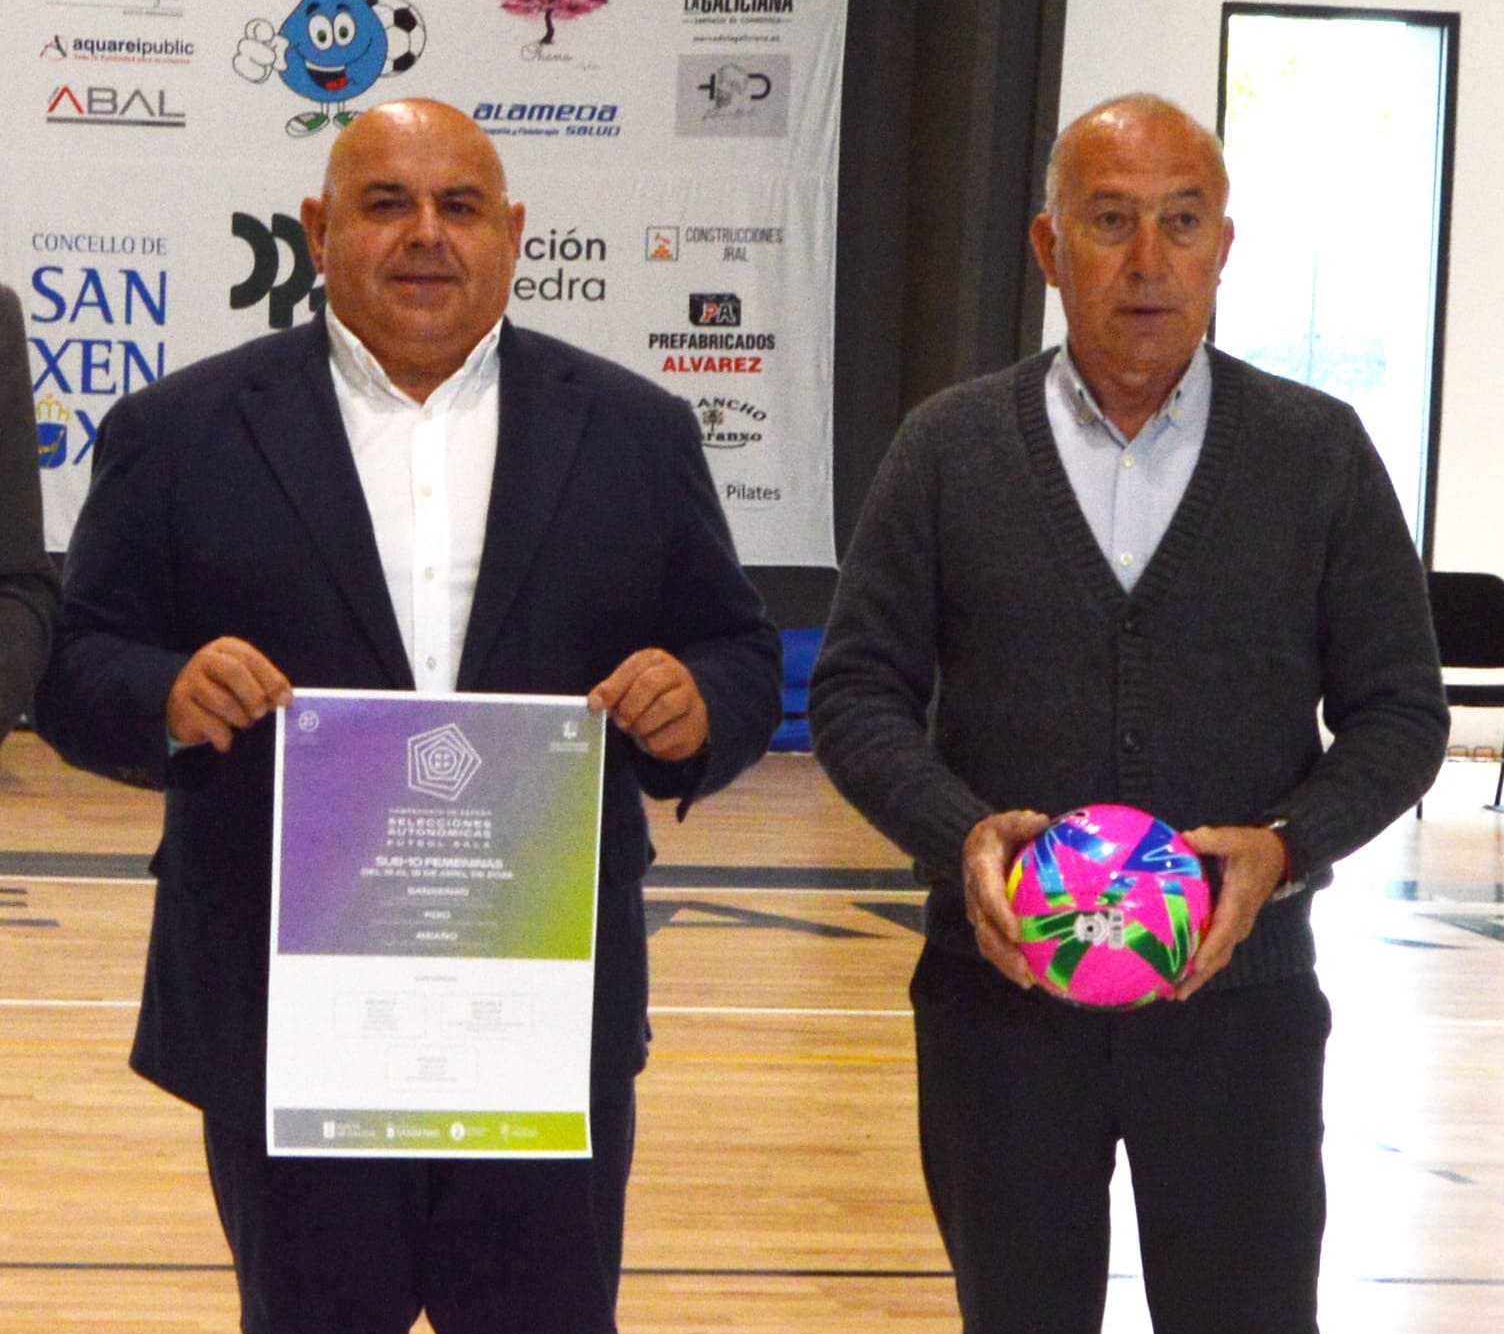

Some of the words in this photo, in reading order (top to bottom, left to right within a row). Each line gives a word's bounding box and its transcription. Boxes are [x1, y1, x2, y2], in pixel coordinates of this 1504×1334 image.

[47, 85, 187, 118] ABAL
[31, 233, 136, 254] CONCELLO
[141, 236, 167, 255] DE
[684, 226, 785, 244] CONSTRUCCIONES
[30, 265, 168, 326] SAN
[648, 333, 777, 350] PREFABRICADOS
[27, 337, 166, 395] XEN
[662, 356, 763, 374] ALVAREZ
[726, 484, 782, 501] Pilates
